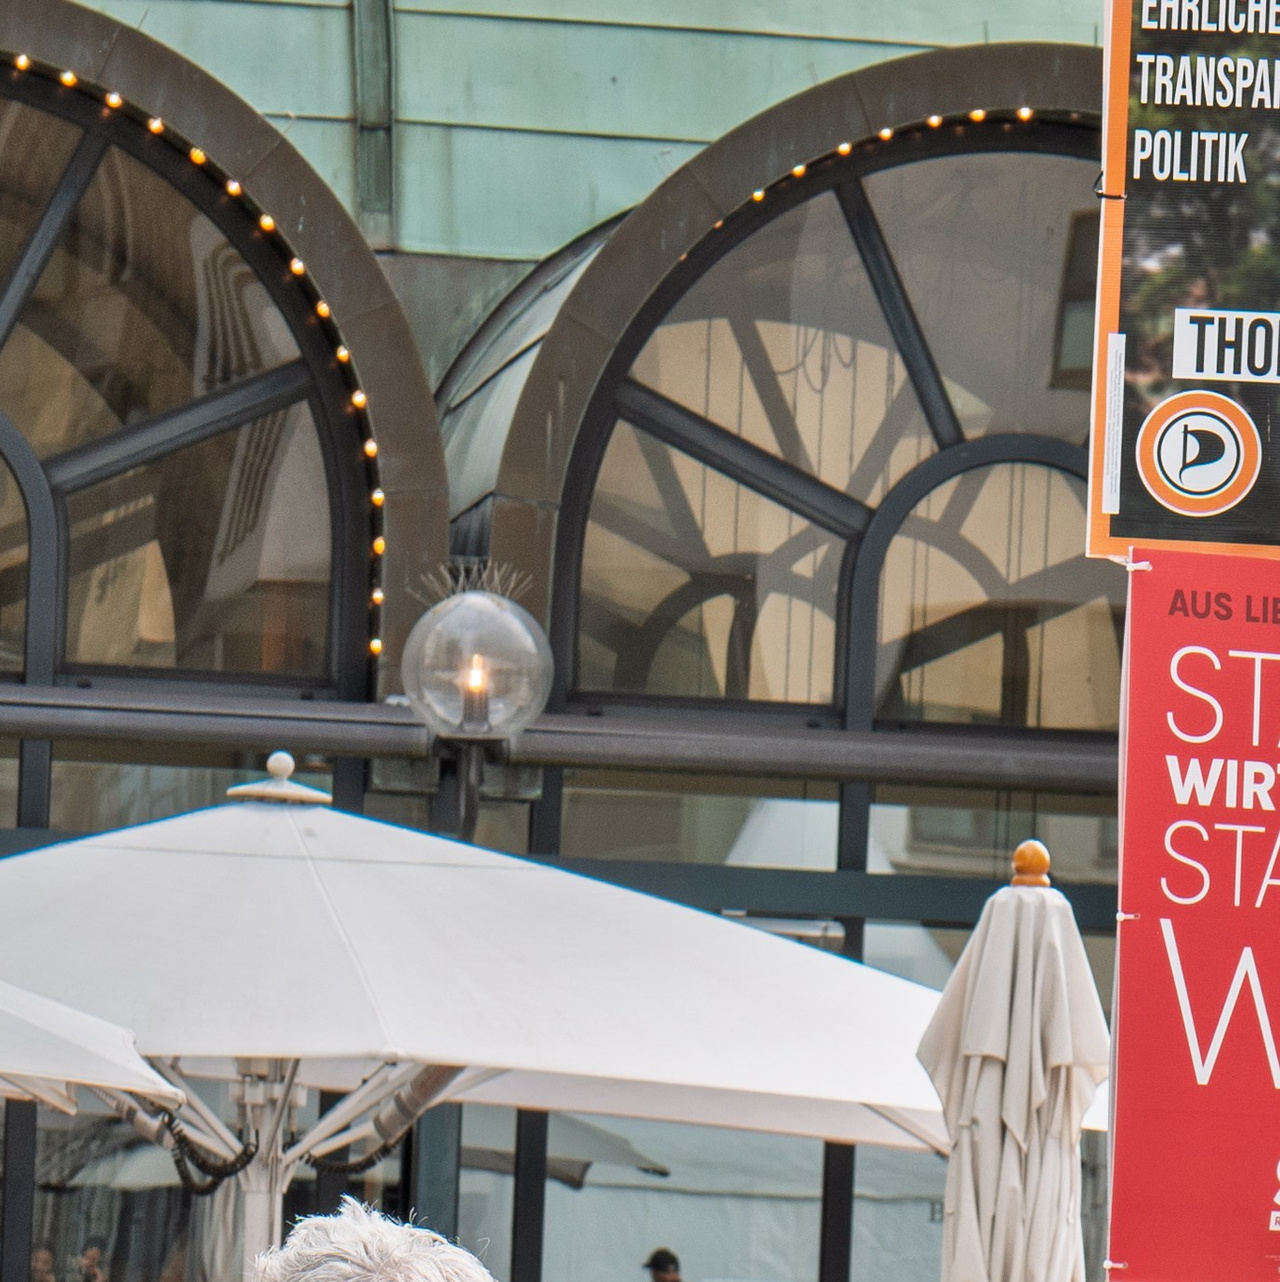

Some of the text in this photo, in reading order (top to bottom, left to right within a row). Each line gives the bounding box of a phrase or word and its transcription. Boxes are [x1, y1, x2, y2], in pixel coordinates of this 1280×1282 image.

[1133, 128, 1249, 184] POLITIK
[1189, 314, 1280, 377] THO
[1168, 588, 1233, 621] AUS
[1166, 645, 1280, 748] ST
[1165, 754, 1280, 811] WIR
